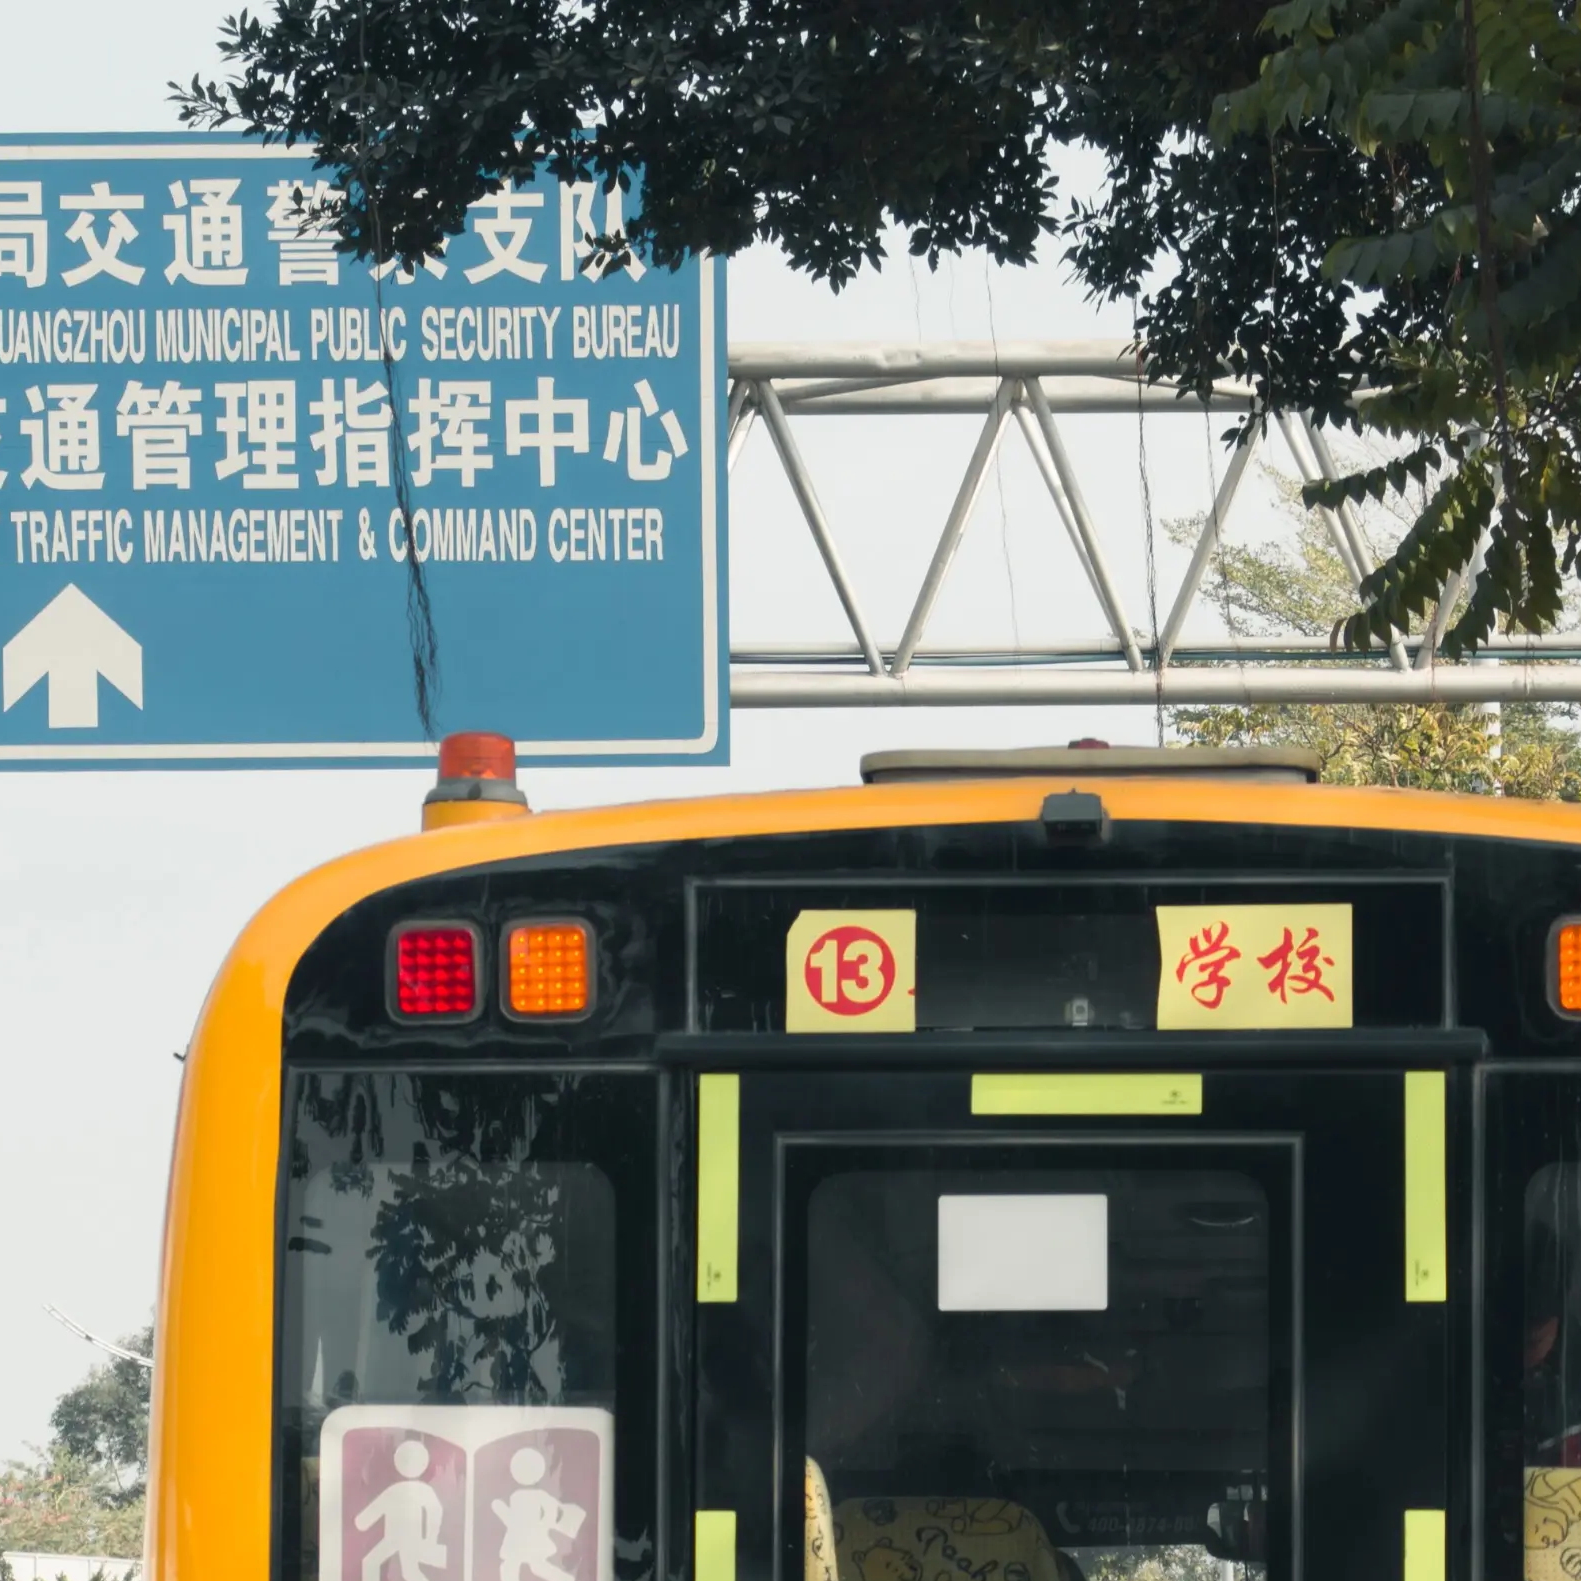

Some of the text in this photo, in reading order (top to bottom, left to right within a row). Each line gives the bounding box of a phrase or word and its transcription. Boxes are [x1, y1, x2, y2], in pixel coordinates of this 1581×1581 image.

[157, 308, 299, 363] MUNICIPAL
[311, 307, 407, 362] PUBLIC
[422, 305, 560, 360] SECURITY
[574, 304, 679, 358] BUREAU
[10, 510, 133, 564] TRAFFIC
[144, 510, 342, 563] MANAGEMENT
[359, 512, 376, 560] &
[388, 508, 536, 562] COMMAND
[549, 508, 663, 561] CENTER
[811, 938, 887, 1003] 13
[1176, 919, 1336, 1010] 学校
